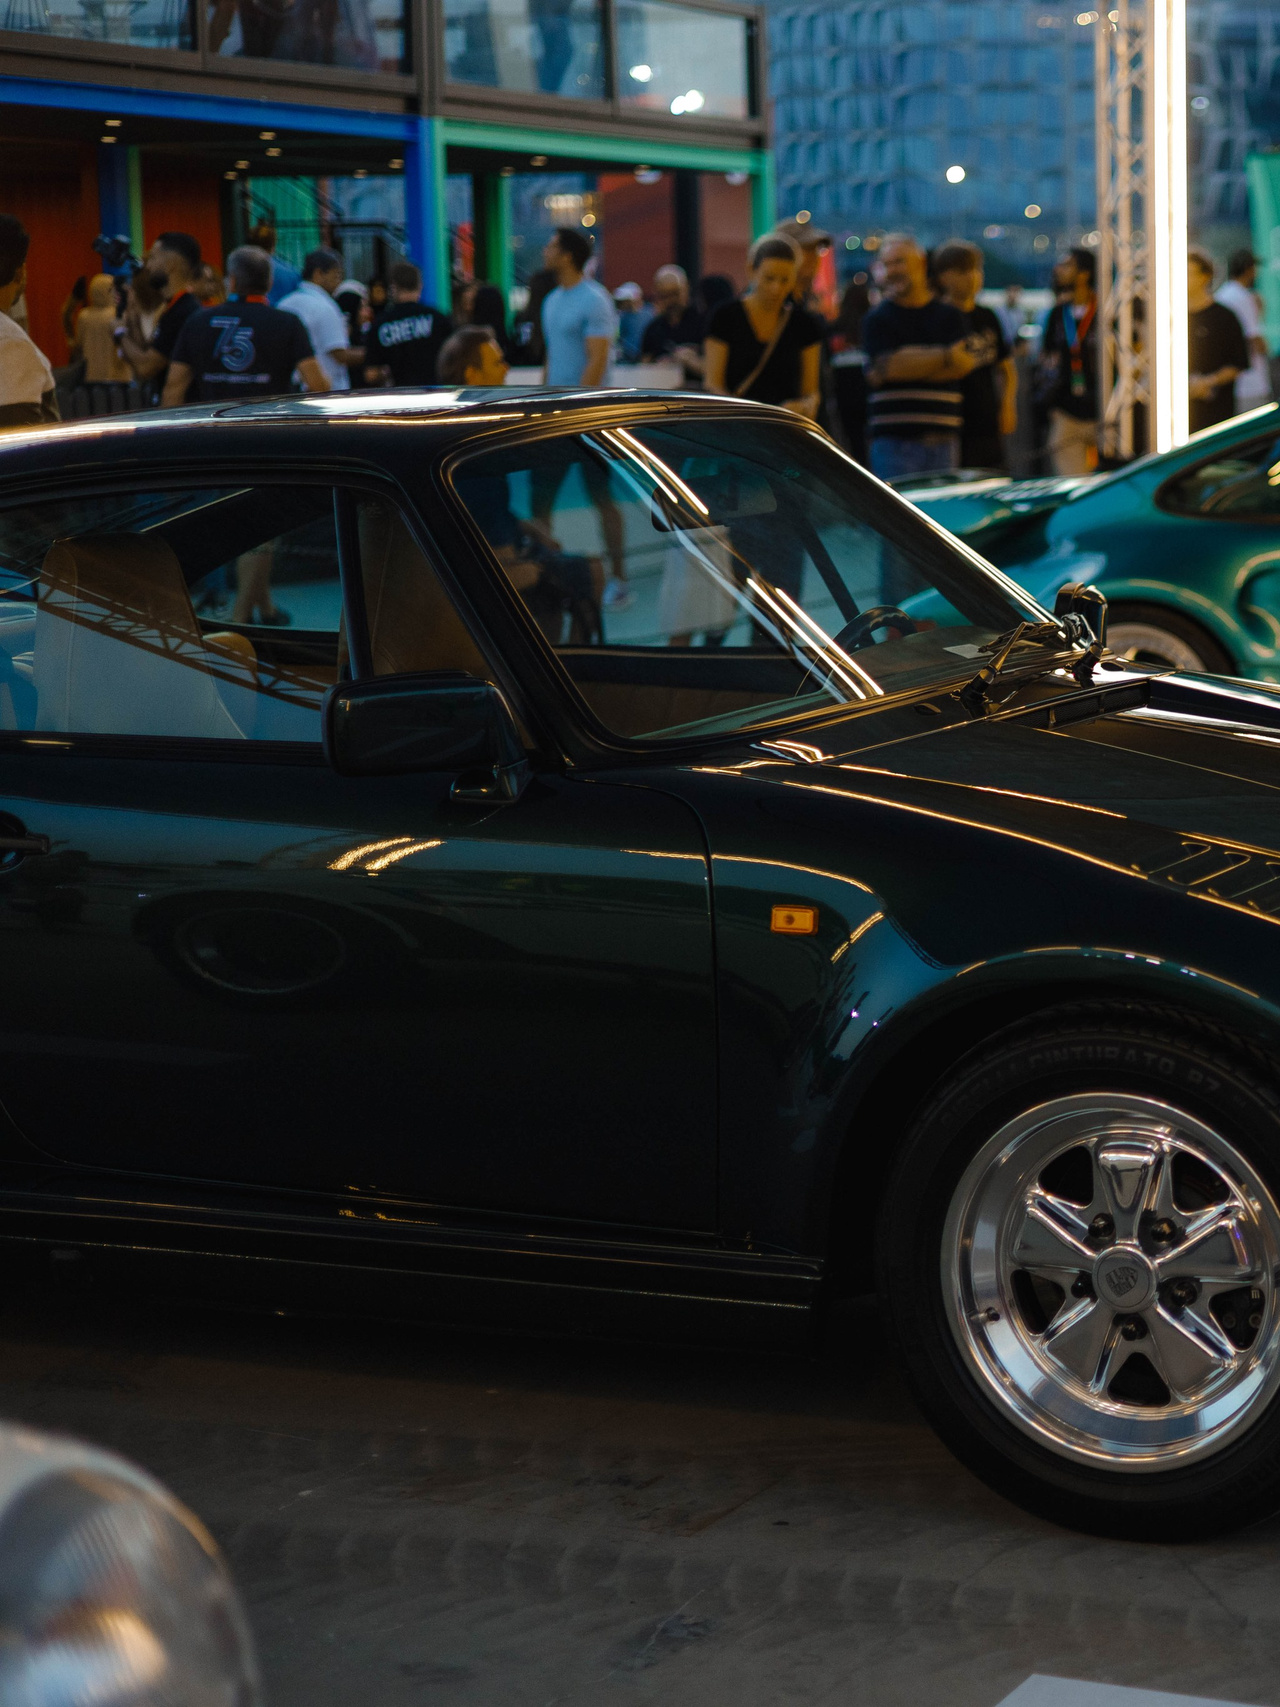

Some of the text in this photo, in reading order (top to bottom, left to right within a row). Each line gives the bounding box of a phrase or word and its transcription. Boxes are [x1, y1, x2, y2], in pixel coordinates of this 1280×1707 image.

[209, 315, 256, 372] 75
[378, 314, 433, 347] CREW
[1029, 1045, 1176, 1075] CINTURATO
[1187, 1068, 1222, 1091] P7
